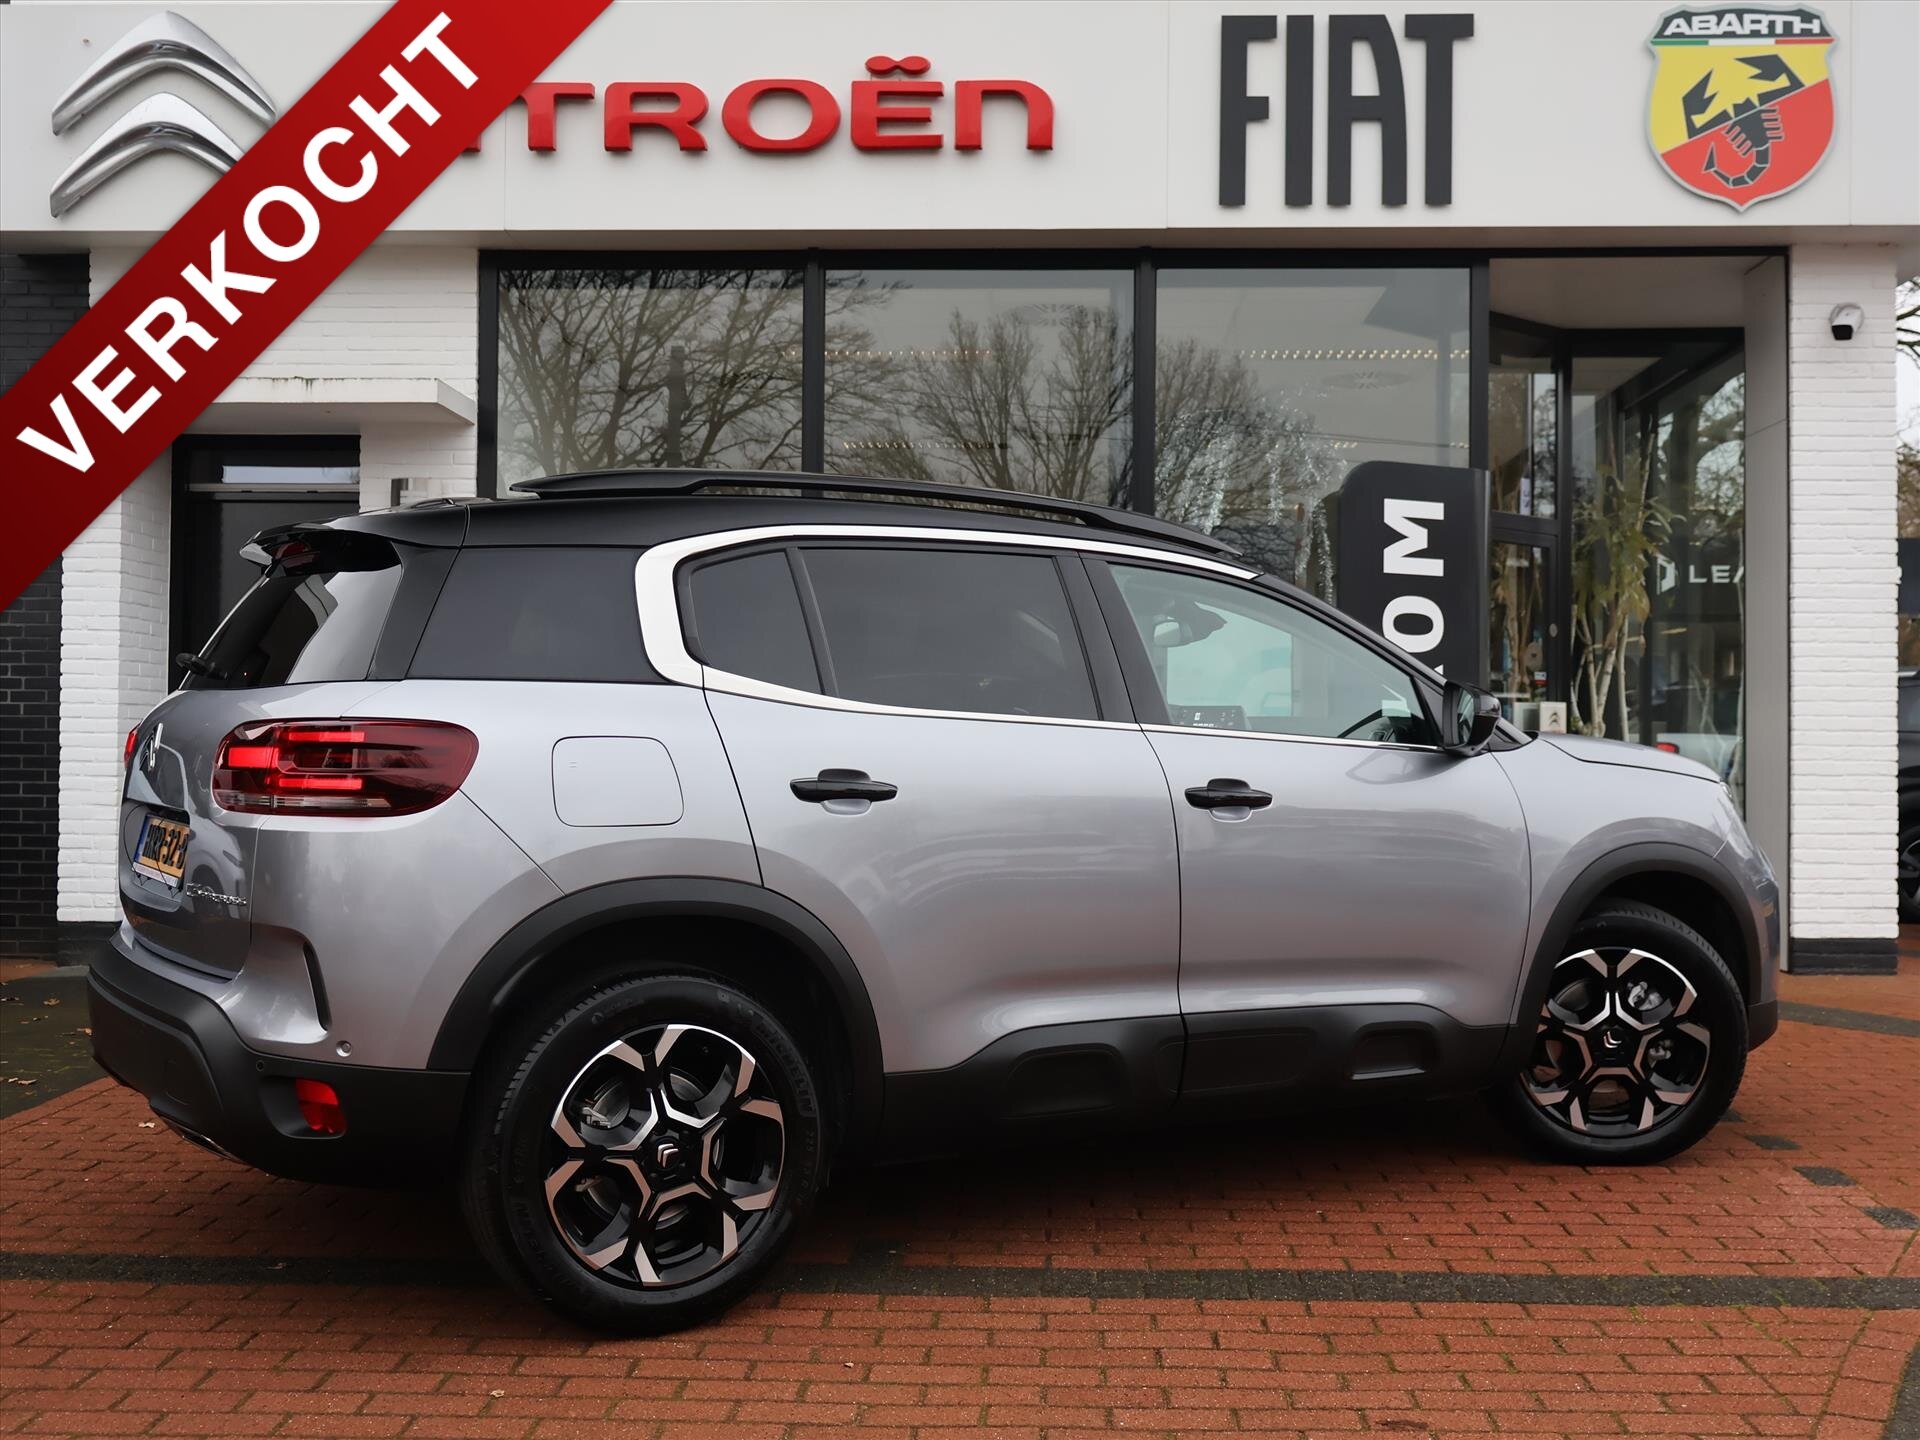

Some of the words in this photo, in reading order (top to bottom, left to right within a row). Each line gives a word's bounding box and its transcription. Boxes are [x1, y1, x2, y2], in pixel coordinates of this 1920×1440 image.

[1664, 13, 1821, 36] ABARTH
[464, 57, 1055, 151] TROËN
[1219, 14, 1474, 206] FIAT
[1382, 498, 1445, 676] OM
